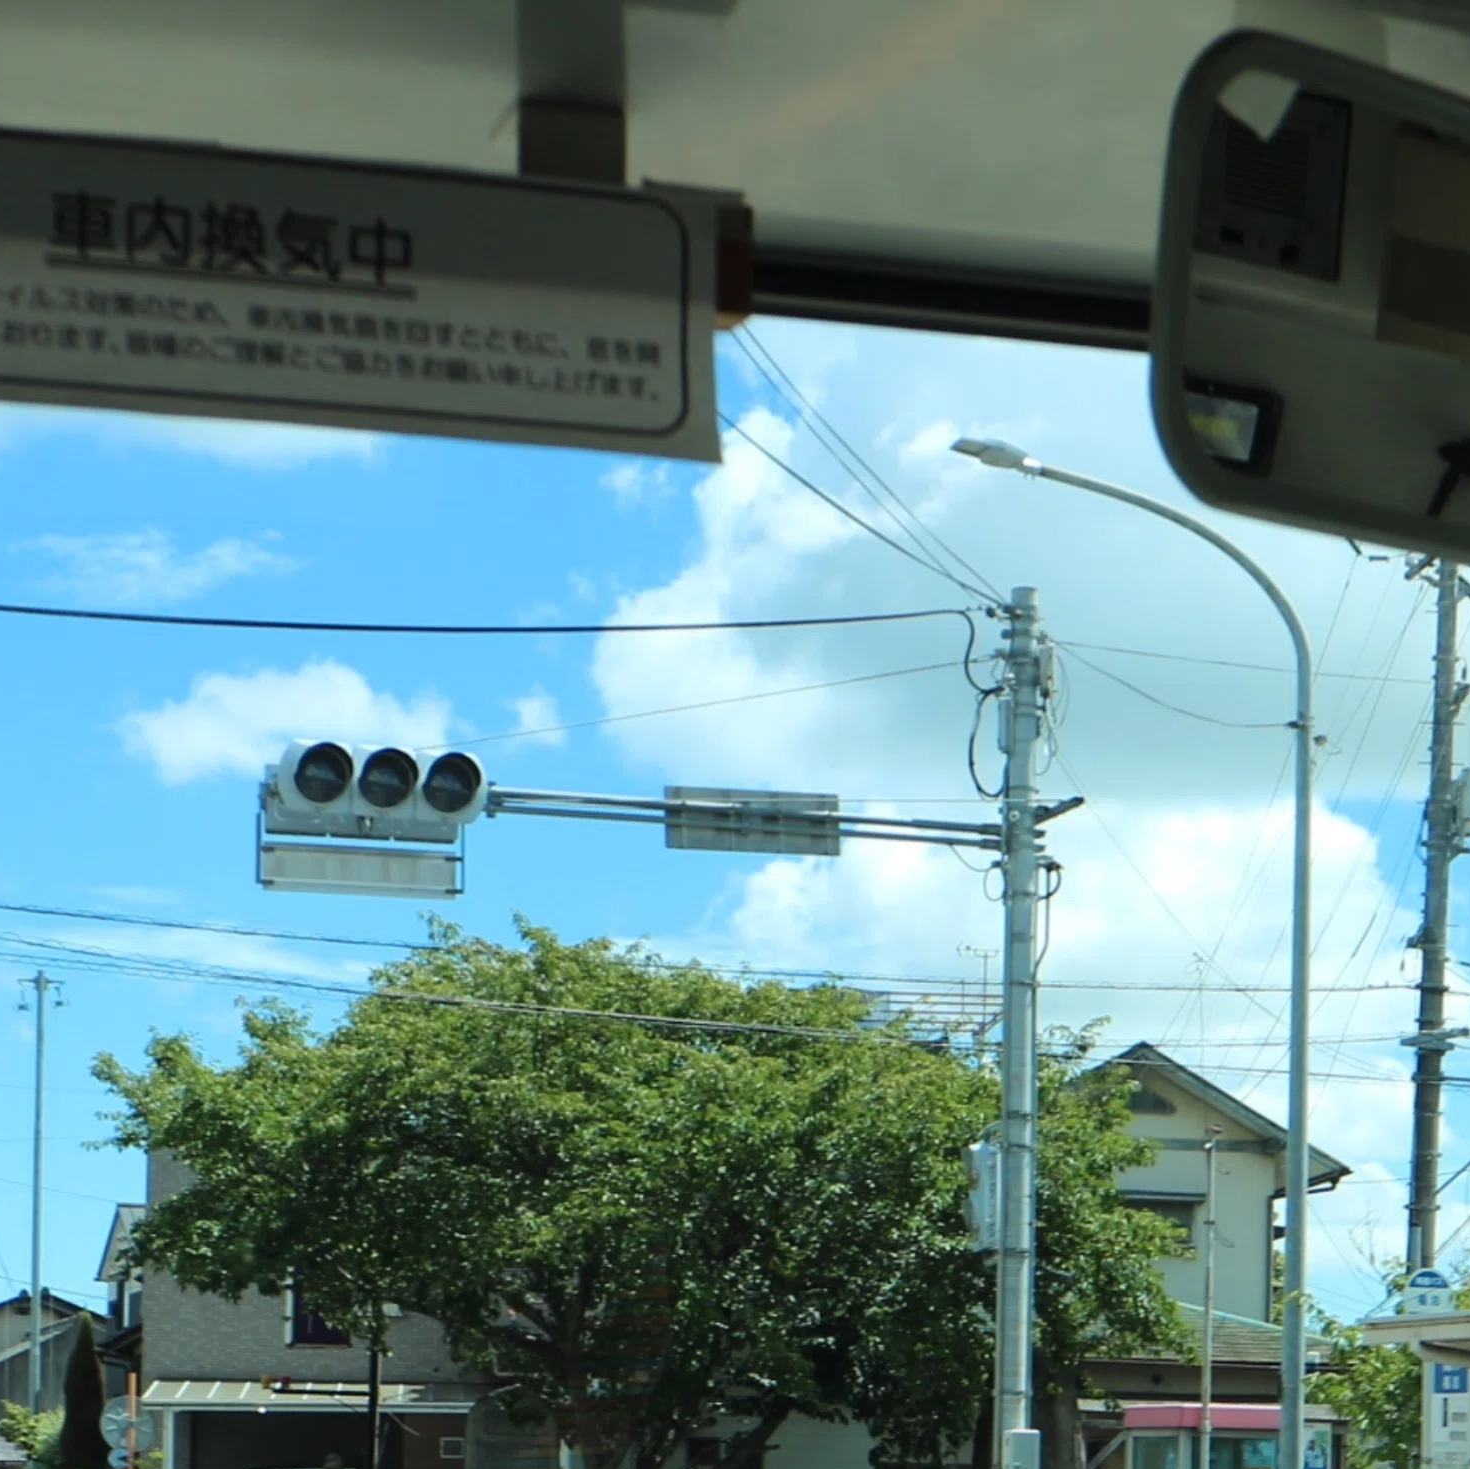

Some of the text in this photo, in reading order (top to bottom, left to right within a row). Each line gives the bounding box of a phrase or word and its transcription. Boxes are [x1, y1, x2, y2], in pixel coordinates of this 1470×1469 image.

[52, 189, 412, 286] 車内換気中
